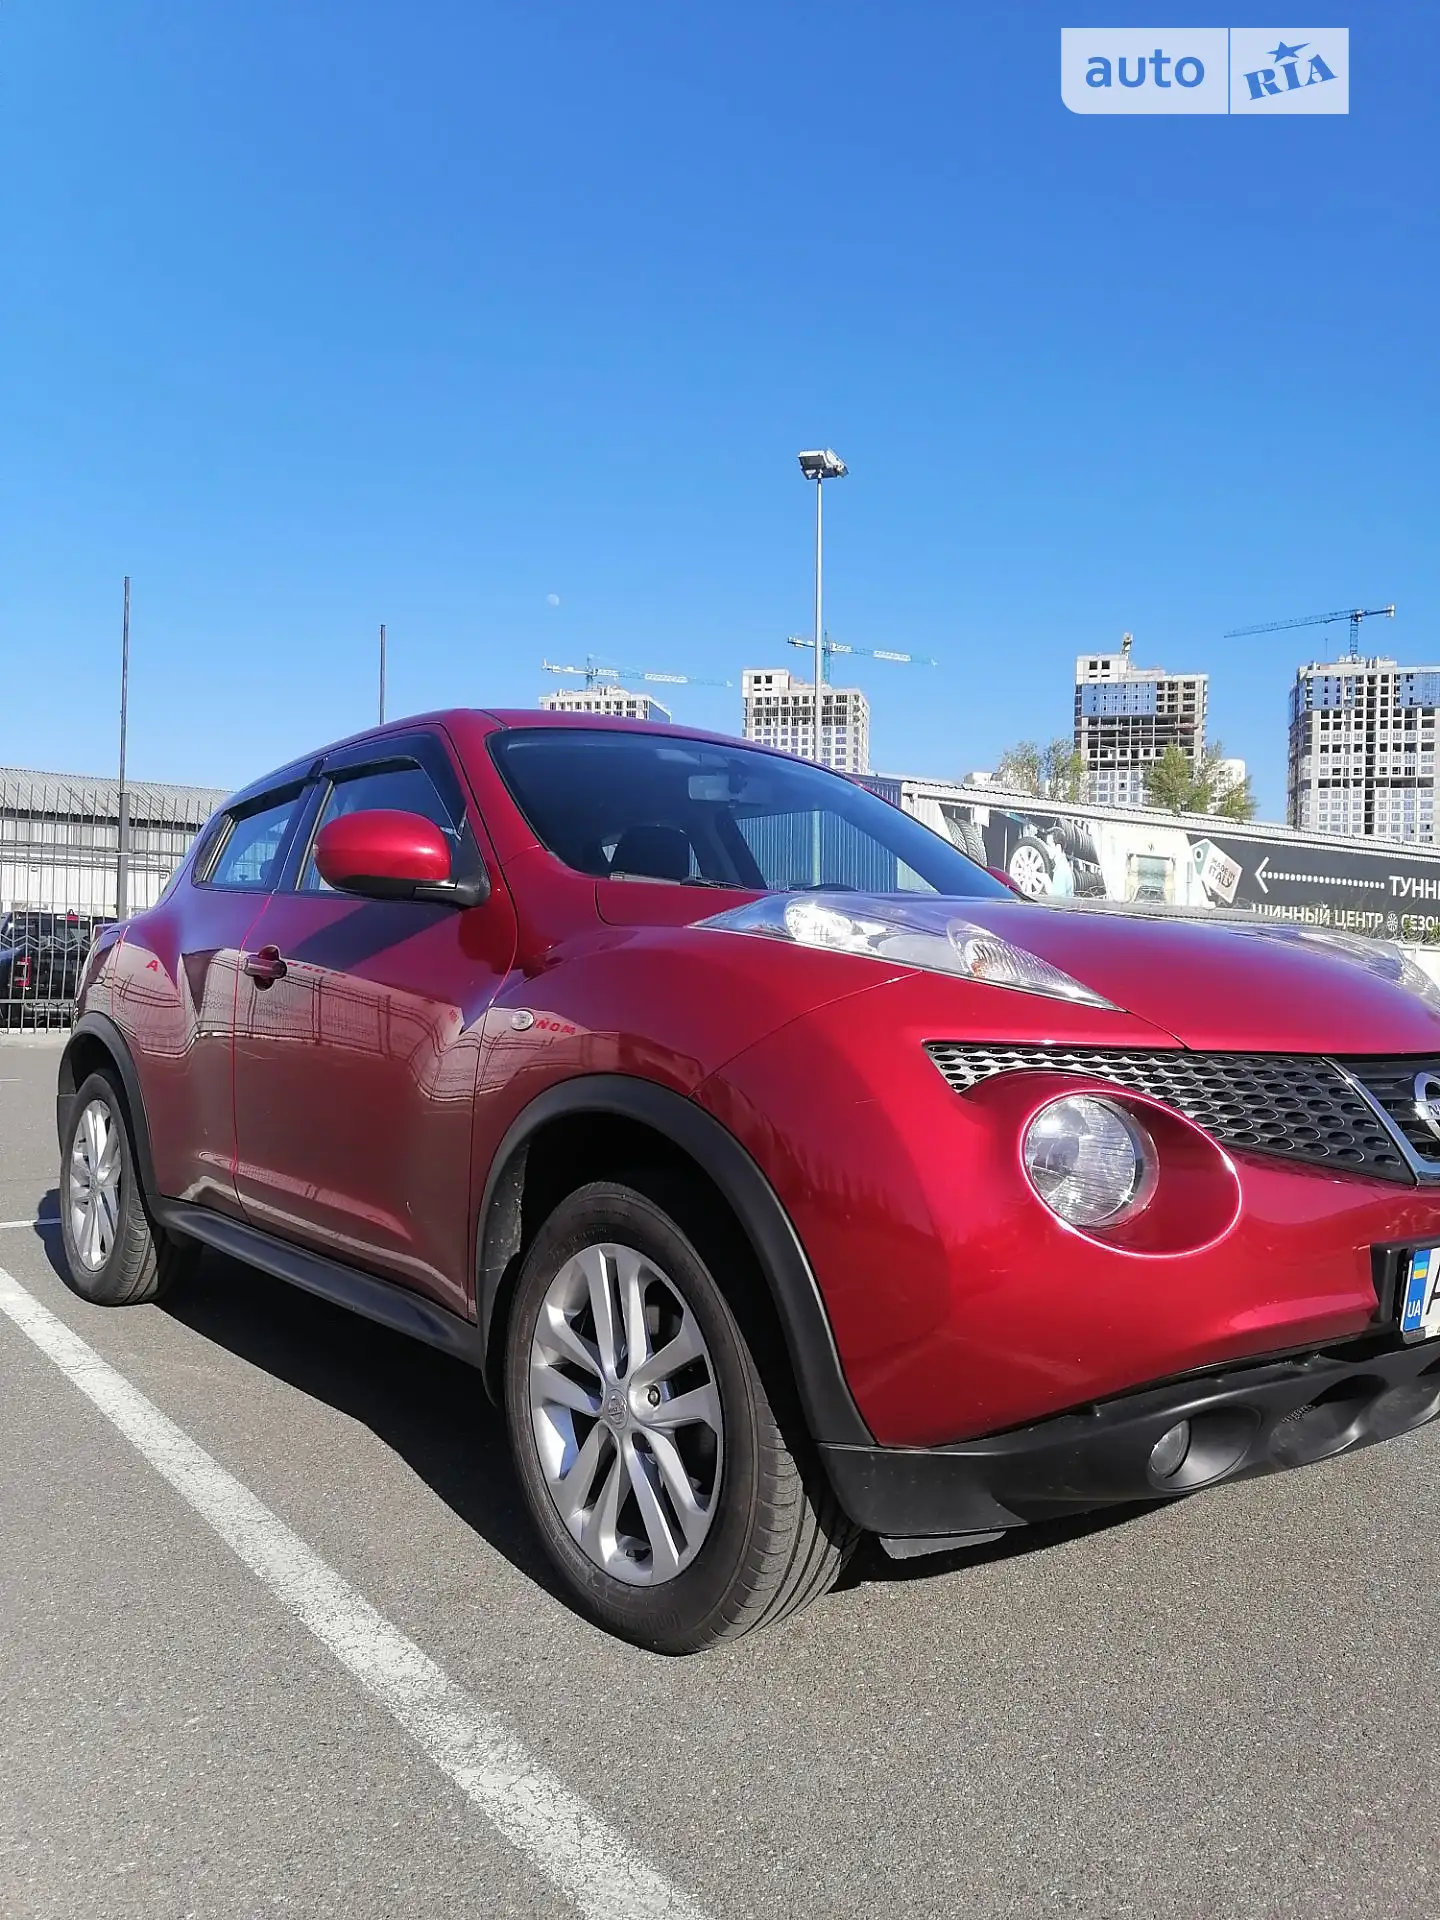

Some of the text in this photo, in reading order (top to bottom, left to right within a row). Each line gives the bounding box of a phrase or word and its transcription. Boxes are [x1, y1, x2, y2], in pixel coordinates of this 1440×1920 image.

[1209, 864, 1233, 888] ITALY
[1388, 874, 1440, 900] ТУНН
[1334, 909, 1384, 930] ЦЕНТР
[1407, 1300, 1421, 1318] UA
